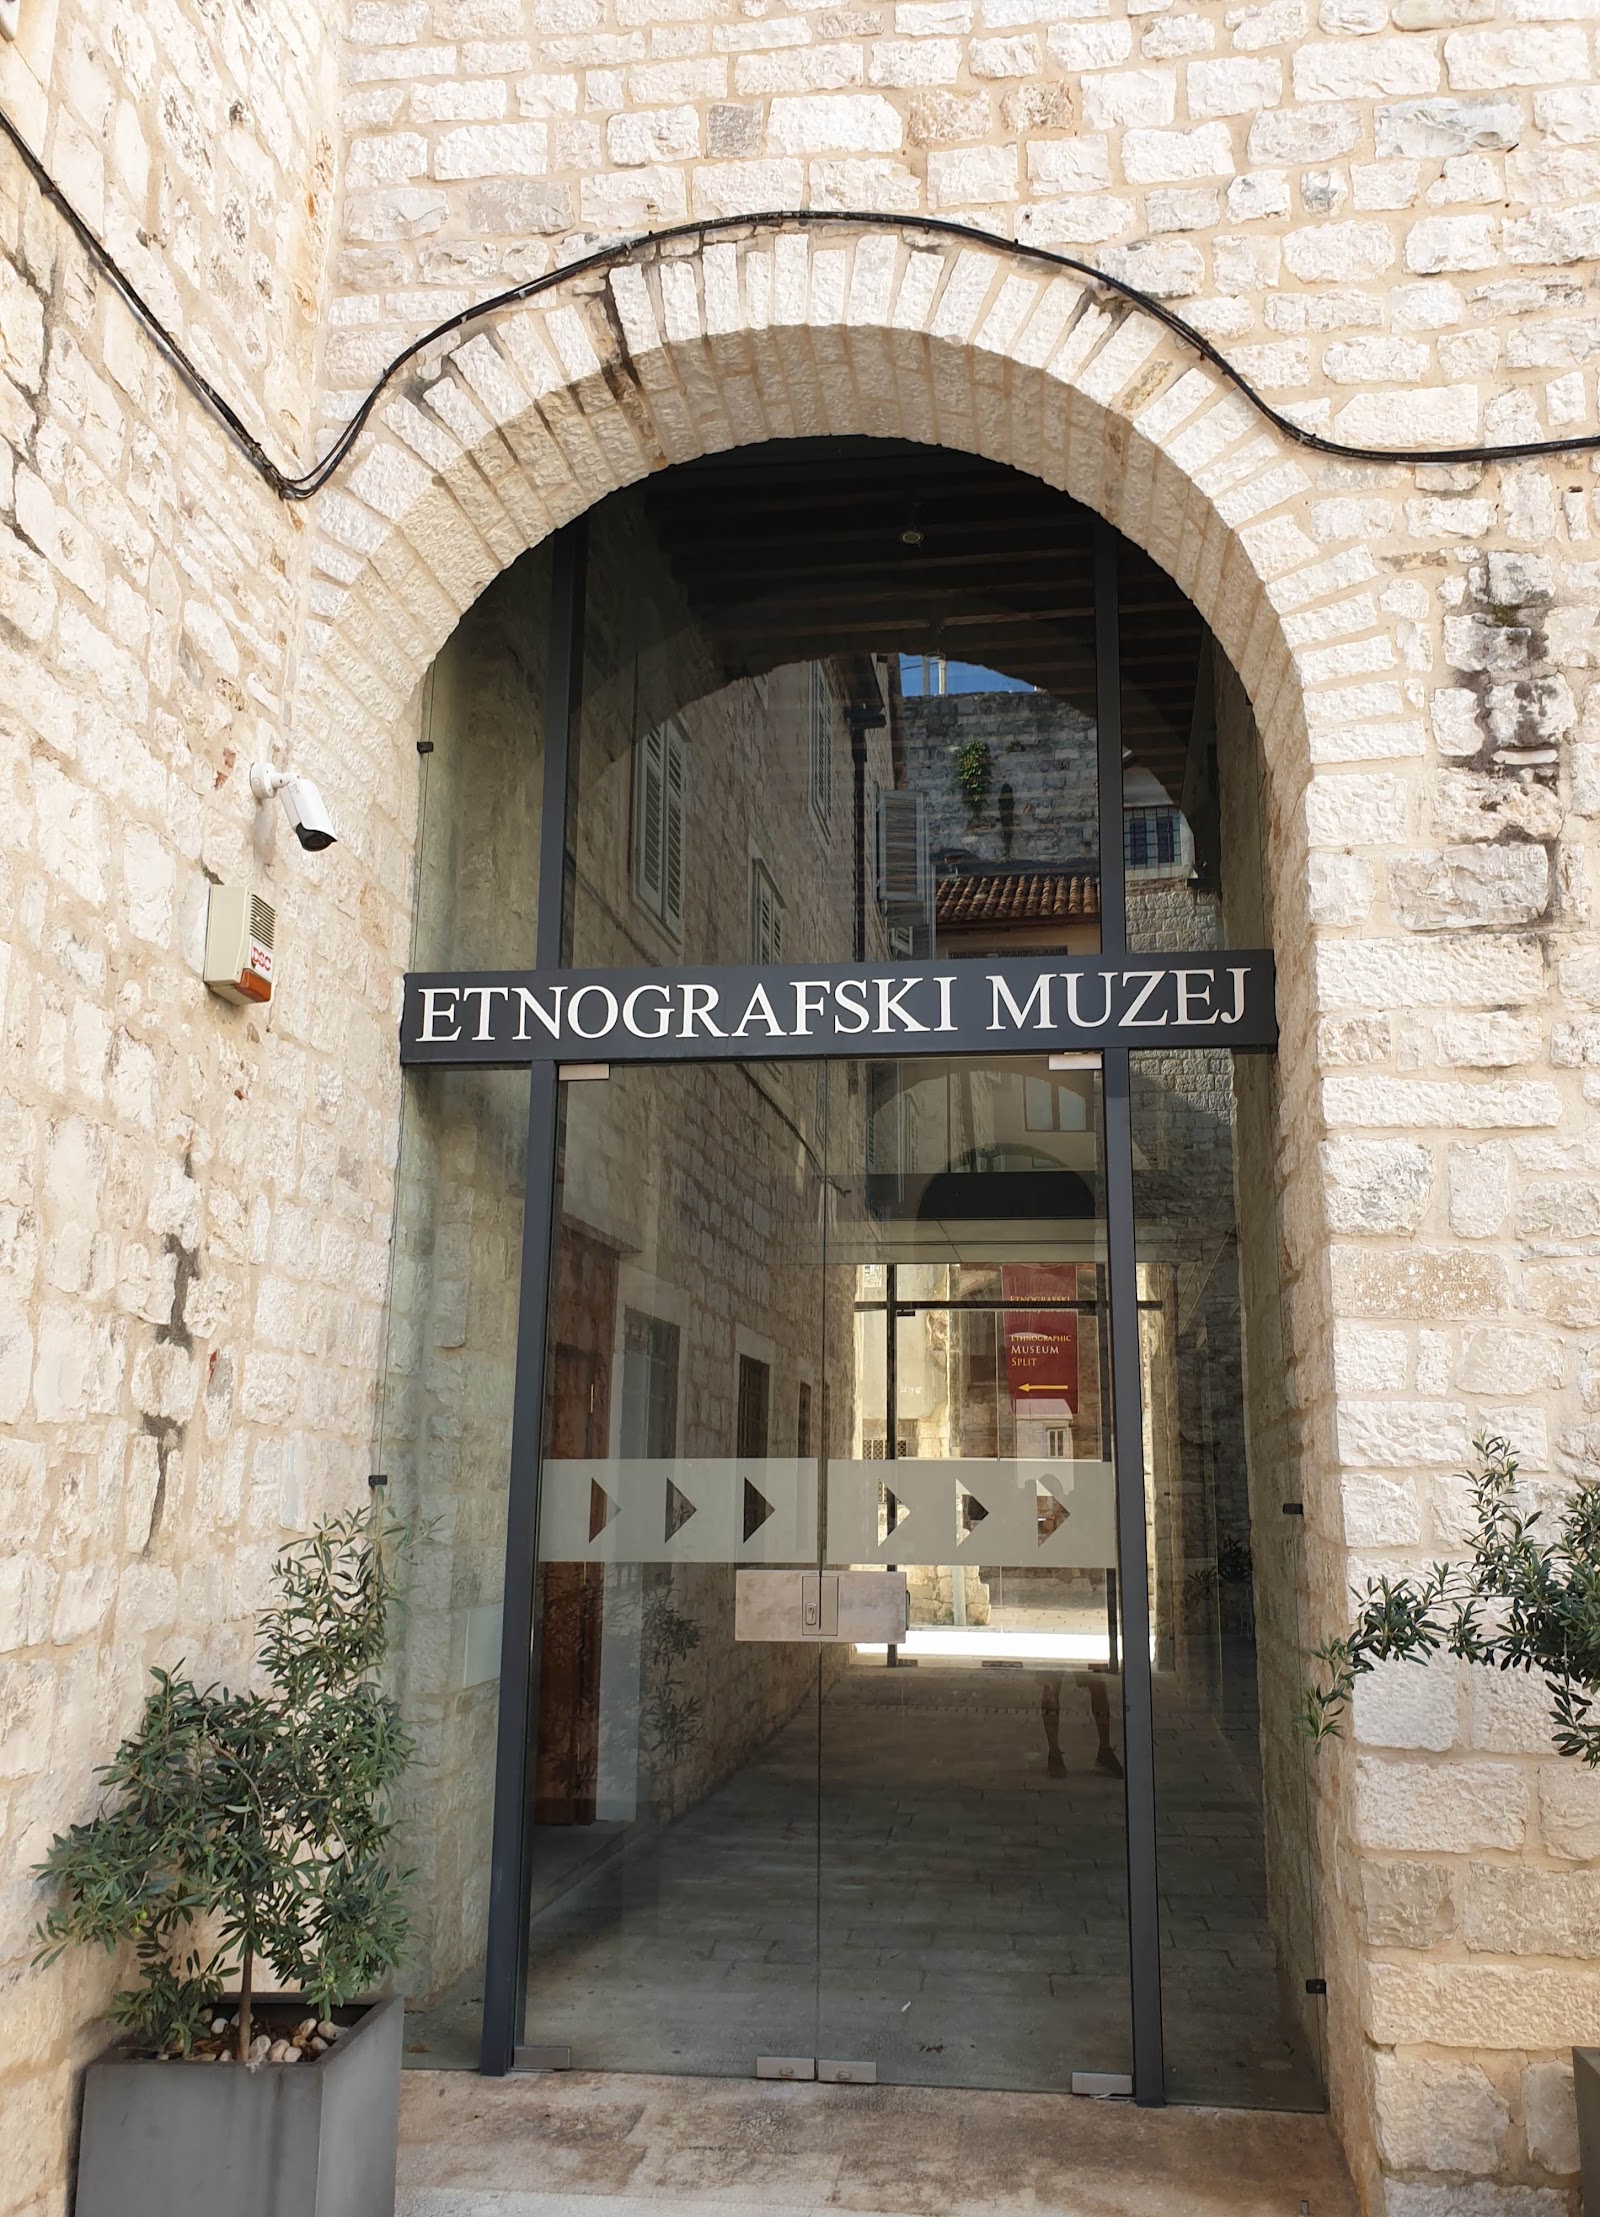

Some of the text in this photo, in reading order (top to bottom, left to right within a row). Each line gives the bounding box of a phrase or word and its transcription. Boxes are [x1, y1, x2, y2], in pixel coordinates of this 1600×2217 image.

[252, 946, 271, 971] DSC
[415, 968, 1251, 1042] ETNOGRAFSKI MUZEJ
[1010, 1334, 1072, 1342] ETHNOGRAPHIC
[1011, 1345, 1059, 1354] MUSEUM
[1011, 1356, 1037, 1367] SPLIT
